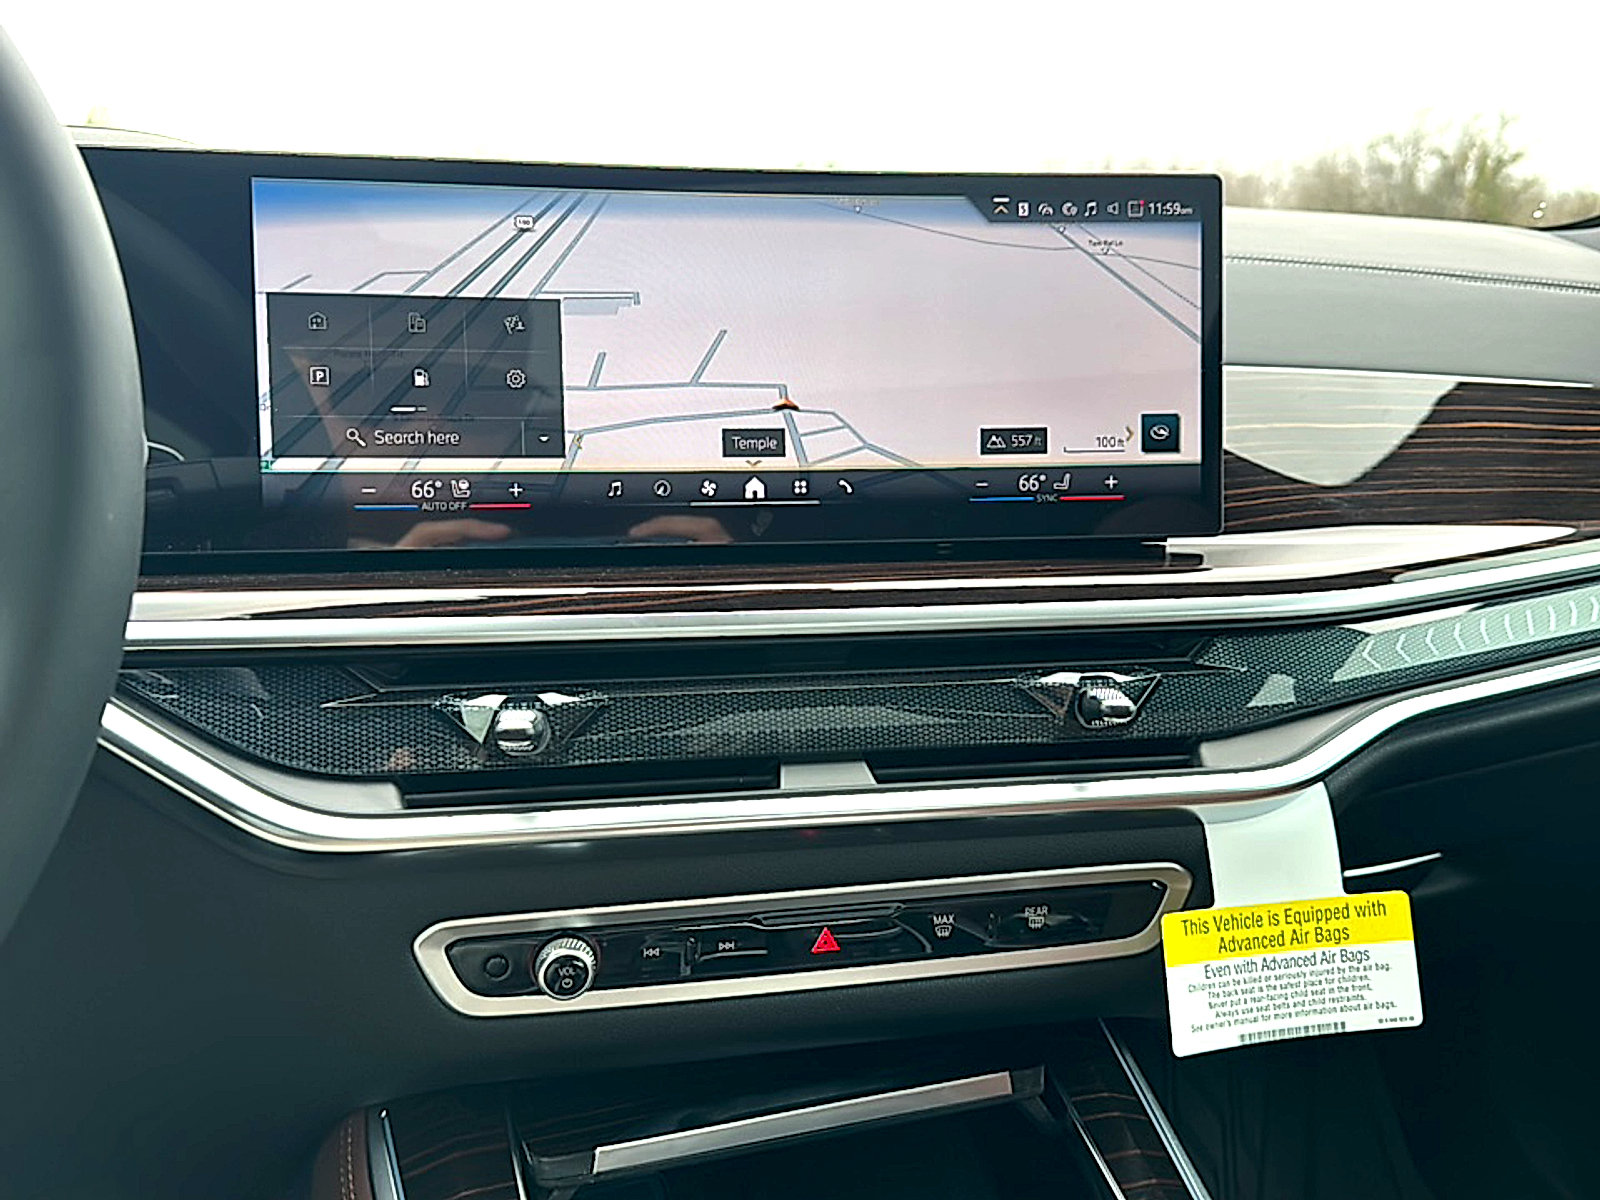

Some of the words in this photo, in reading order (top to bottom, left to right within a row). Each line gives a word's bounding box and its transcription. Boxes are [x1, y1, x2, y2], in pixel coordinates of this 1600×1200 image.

[374, 430, 425, 445] Search
[427, 430, 460, 445] here
[731, 436, 778, 451] Temple
[421, 502, 447, 511] AUTO
[449, 502, 467, 511] OFF
[1036, 494, 1058, 503] SYNC
[933, 913, 955, 925] MAX
[1024, 905, 1049, 918] REAR
[1181, 917, 1210, 936] This
[1213, 912, 1263, 932] Vehicle
[1267, 910, 1280, 926] is
[1284, 902, 1350, 927] Equipped
[1354, 900, 1387, 918] with
[1218, 930, 1285, 954] Advanced
[1290, 929, 1309, 946] Air
[1314, 926, 1350, 944] Bags
[558, 966, 576, 977] VOL
[1204, 964, 1231, 980] Even
[1234, 958, 1258, 975] with
[1261, 952, 1316, 972] Advanced
[1320, 950, 1337, 965] Air
[1340, 948, 1370, 964] Bags
[1188, 982, 1216, 993] Children
[1218, 980, 1230, 988] can
[1232, 979, 1241, 987] be
[1243, 975, 1262, 984] killed
[1273, 970, 1307, 981] seriously
[1309, 967, 1335, 977] injured
[1337, 966, 1346, 975] by
[1348, 965, 1360, 973] the
[1363, 964, 1372, 972] air
[1208, 991, 1220, 999] The
[1222, 989, 1239, 998] back
[1241, 986, 1255, 995] seat
[1279, 980, 1301, 990] safest
[1303, 978, 1323, 988] place
[1324, 976, 1335, 985] for
[1230, 997, 1241, 1008] put
[1250, 992, 1289, 1004] rear-facing
[1290, 989, 1308, 999] child
[1310, 987, 1326, 996] seat
[1337, 985, 1349, 993] the
[1191, 1024, 1203, 1033] See
[1234, 1015, 1259, 1026] manual
[1261, 1014, 1271, 1022] for
[1273, 1011, 1292, 1020] more
[1294, 1006, 1337, 1017] information
[1339, 1003, 1361, 1012] about
[1363, 1002, 1373, 1010] air
[1216, 1009, 1239, 1019] Always
[1241, 1007, 1253, 1015] use
[1256, 1003, 1271, 1013] seat
[1272, 1002, 1290, 1011] belts
[1292, 999, 1306, 1008] and
[1308, 997, 1326, 1006] child
